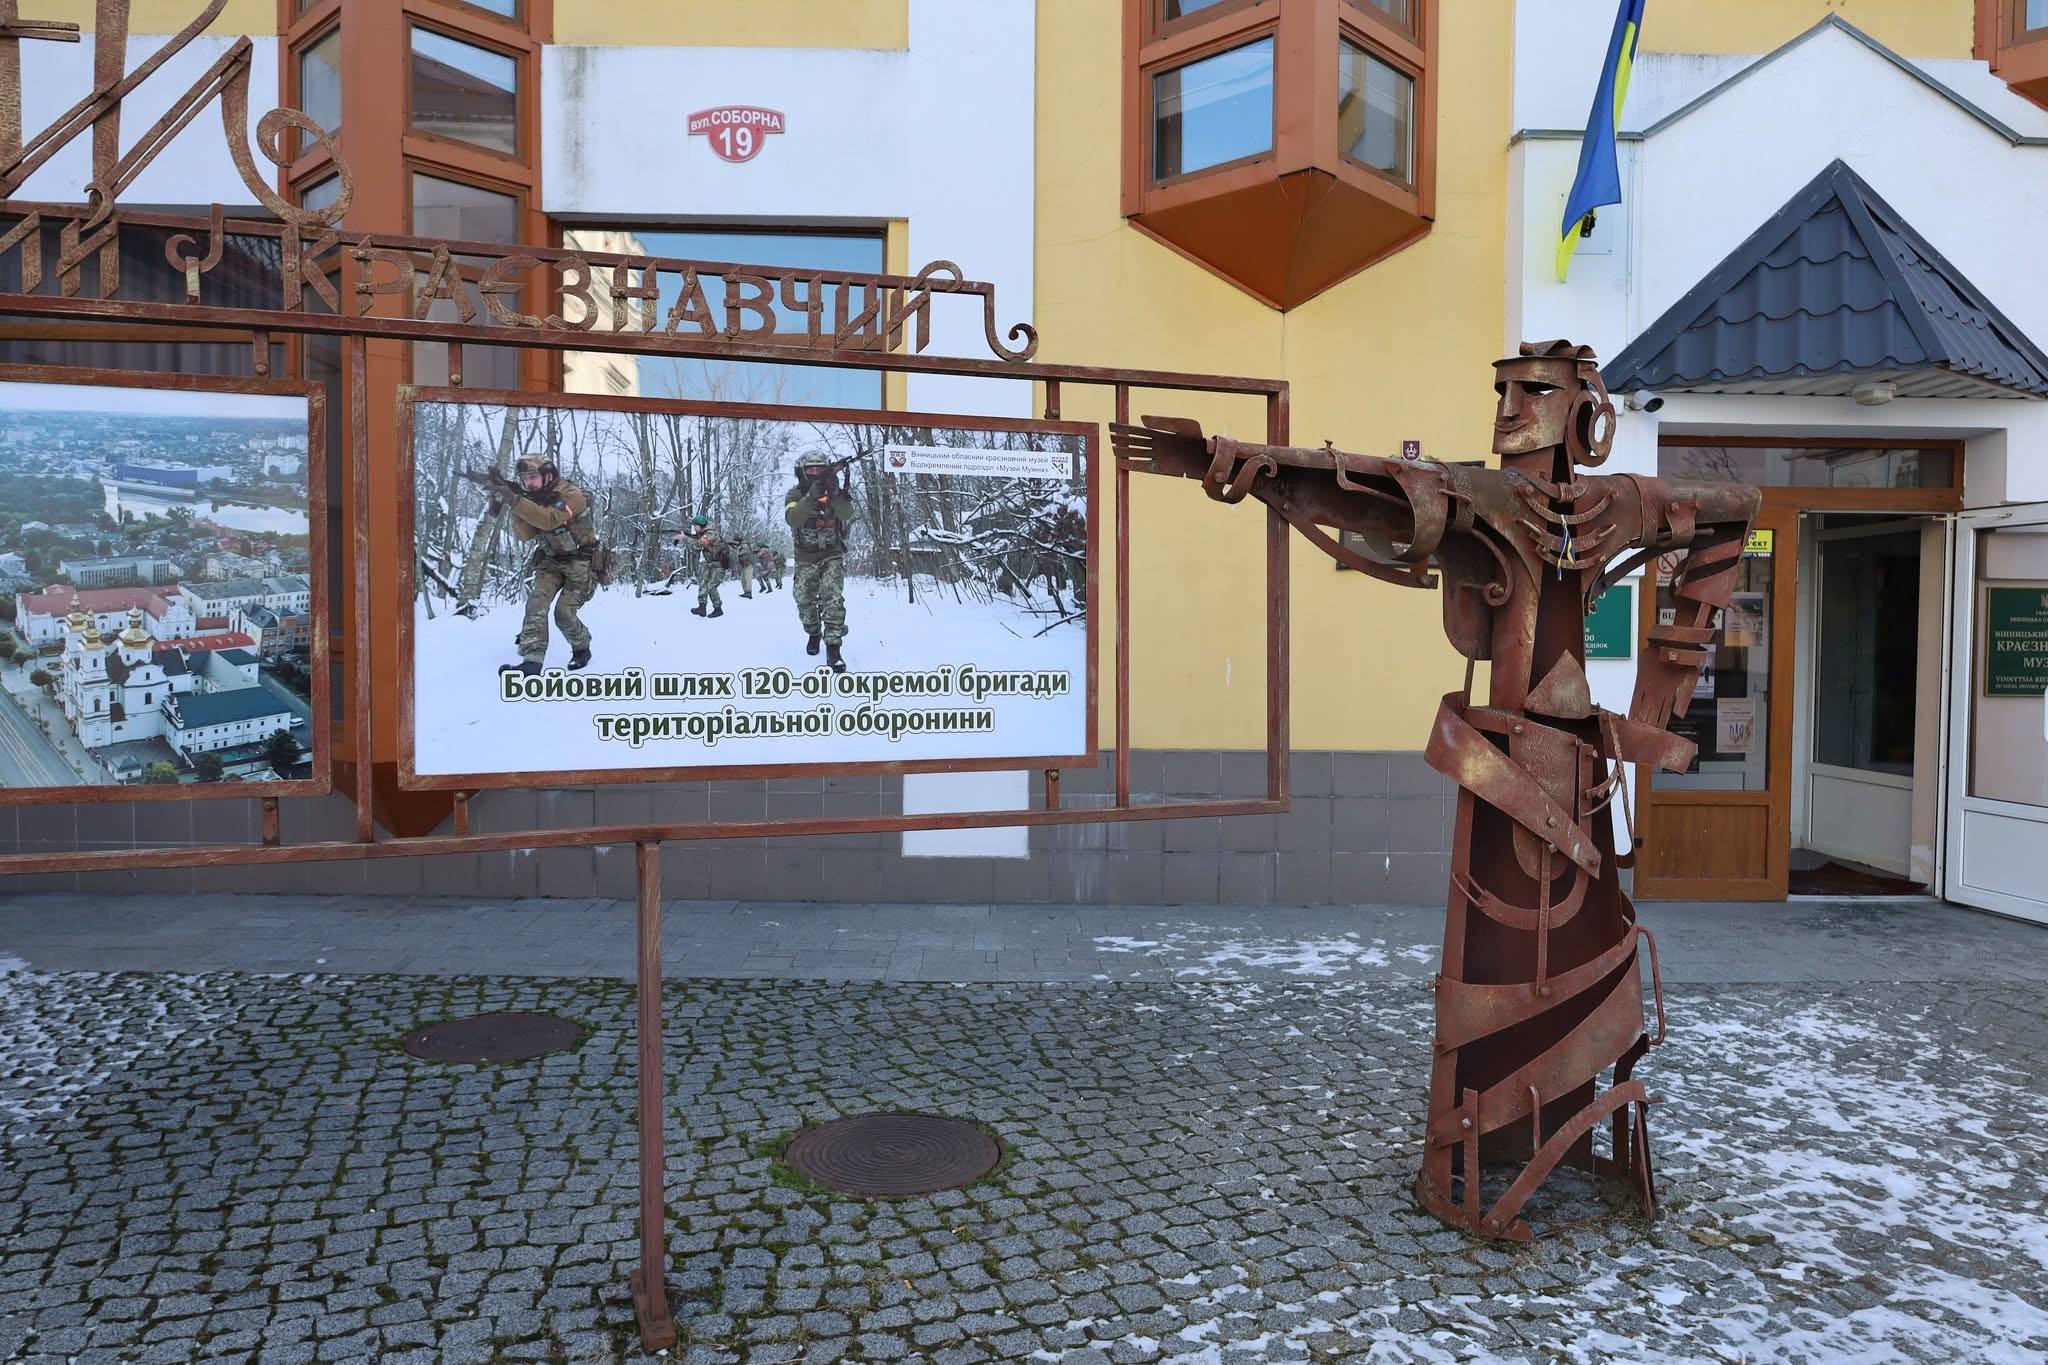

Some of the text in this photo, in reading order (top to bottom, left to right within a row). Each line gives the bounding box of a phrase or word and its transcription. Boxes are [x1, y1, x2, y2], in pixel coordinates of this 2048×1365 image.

[711, 110, 781, 130] СОБОРНА
[719, 126, 753, 157] 19
[280, 222, 964, 354] КРАЄЗНАВЧИЙ
[504, 667, 1067, 701] Бойовий шлях 120-ої окремої бригади
[597, 705, 992, 744] територіальної оборонини
